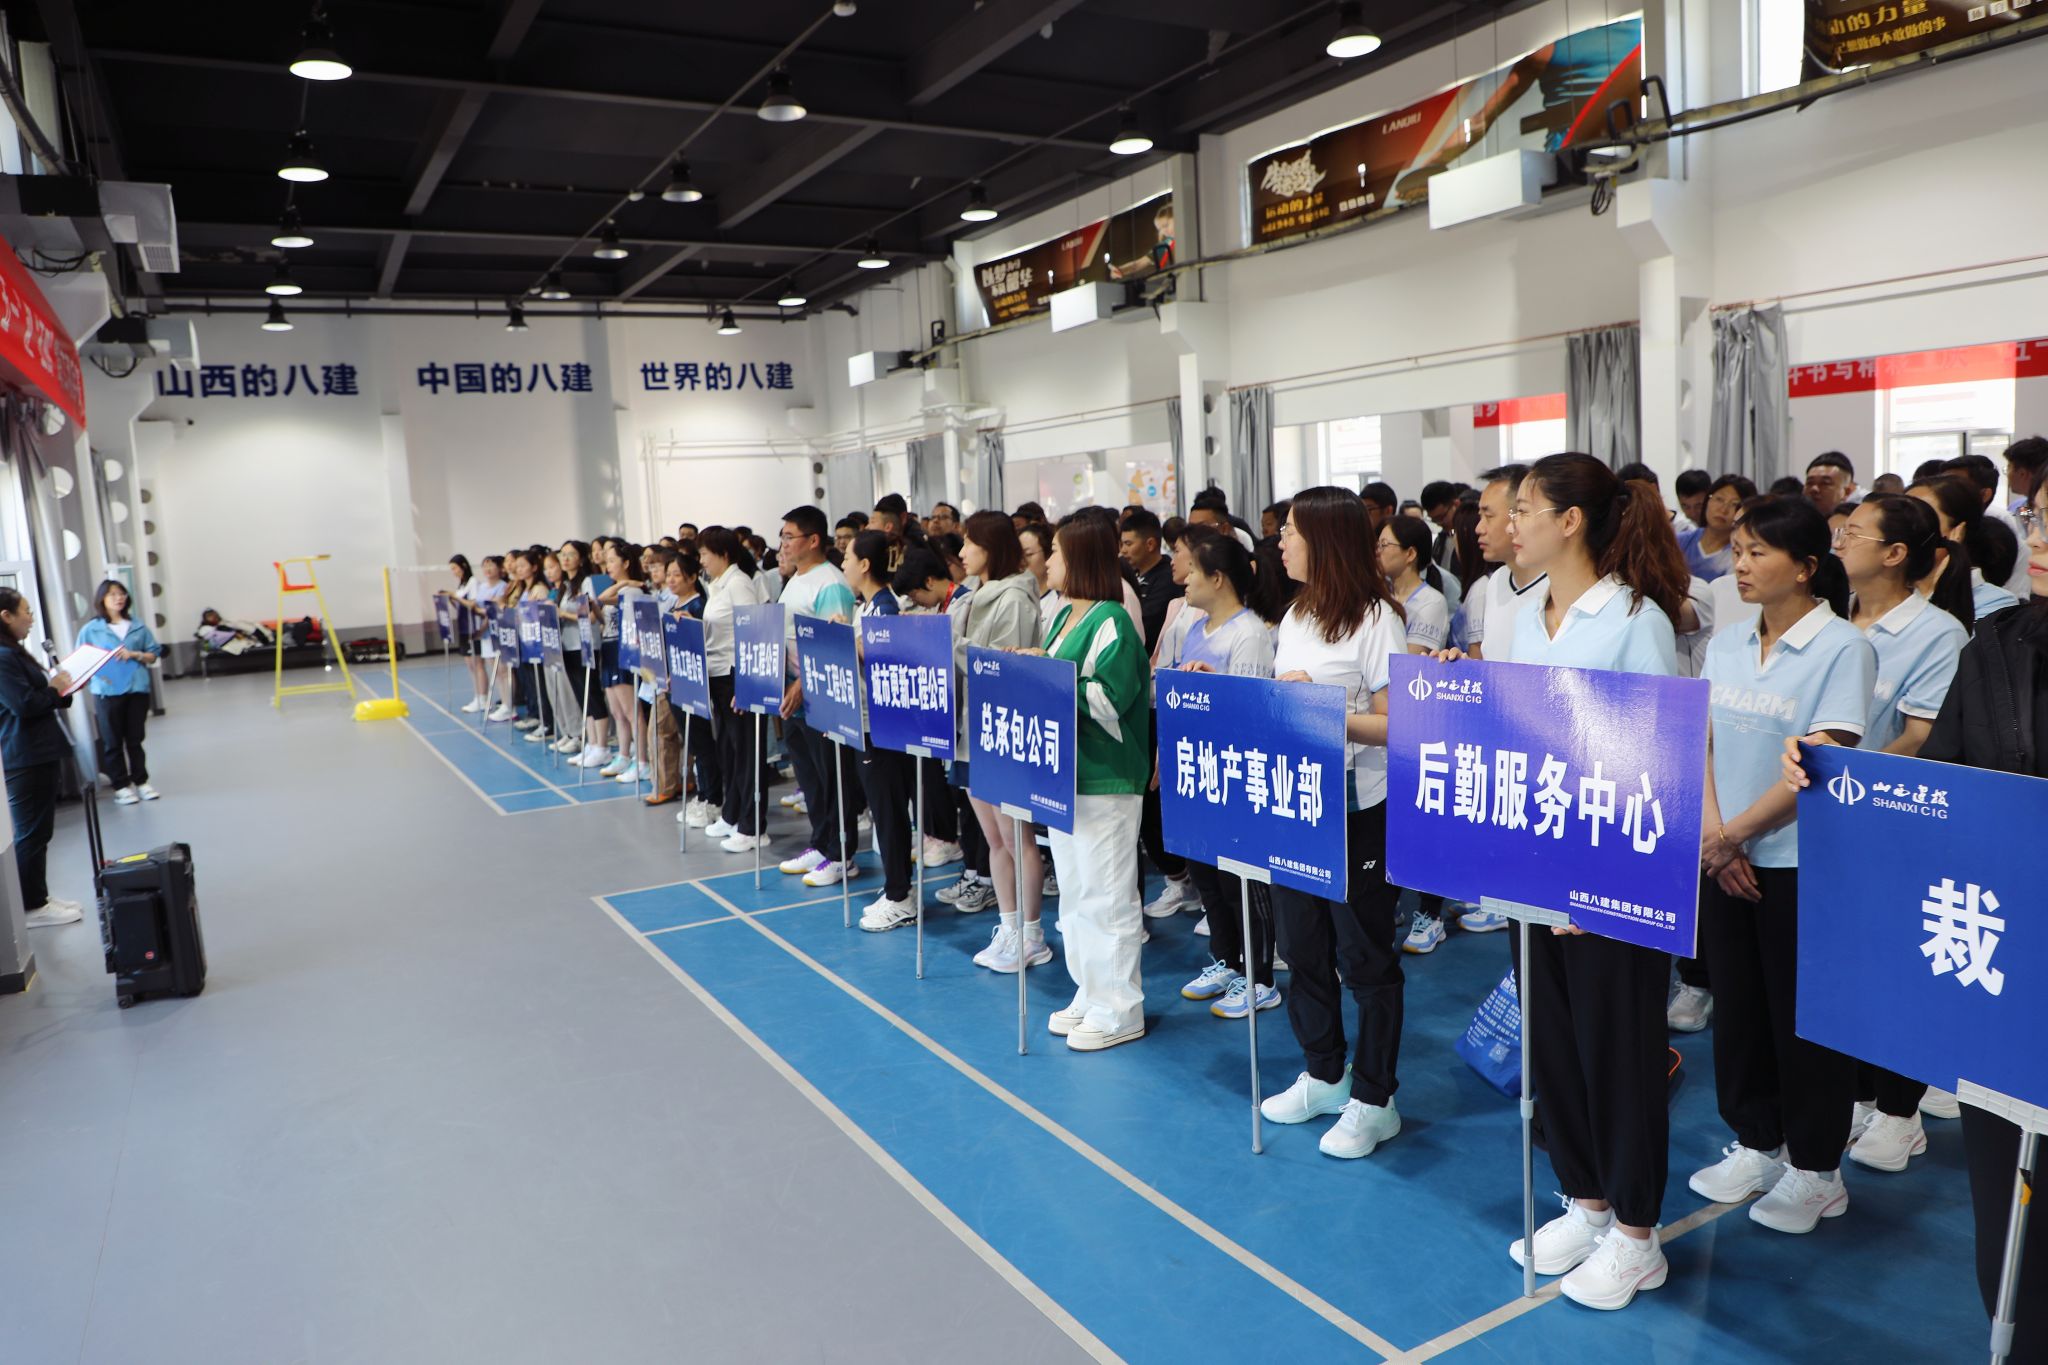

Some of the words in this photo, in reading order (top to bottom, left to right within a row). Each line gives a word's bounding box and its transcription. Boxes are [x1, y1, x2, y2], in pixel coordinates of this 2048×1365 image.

[157, 363, 360, 398] 山西的八建
[417, 362, 593, 394] 中国的八建
[640, 362, 794, 391] 世界的八建
[739, 641, 780, 679] 第十工程公司
[803, 654, 856, 710] 第十一工程公司
[870, 662, 948, 714] 城市更新工程公司
[1436, 692, 1464, 702] SHANXI
[1465, 695, 1482, 704] CIG
[980, 701, 1060, 774] 总承包公司
[1176, 736, 1323, 827] 房地产事业部
[1415, 741, 1666, 854] 后勤服务中心
[1872, 797, 1918, 813] SHANXI
[1921, 806, 1948, 819] CIG
[1268, 854, 1332, 880] 山西八建集团有限公司
[1569, 890, 1676, 924] 山西八建集团有限公司
[1919, 877, 2006, 996] 裁
